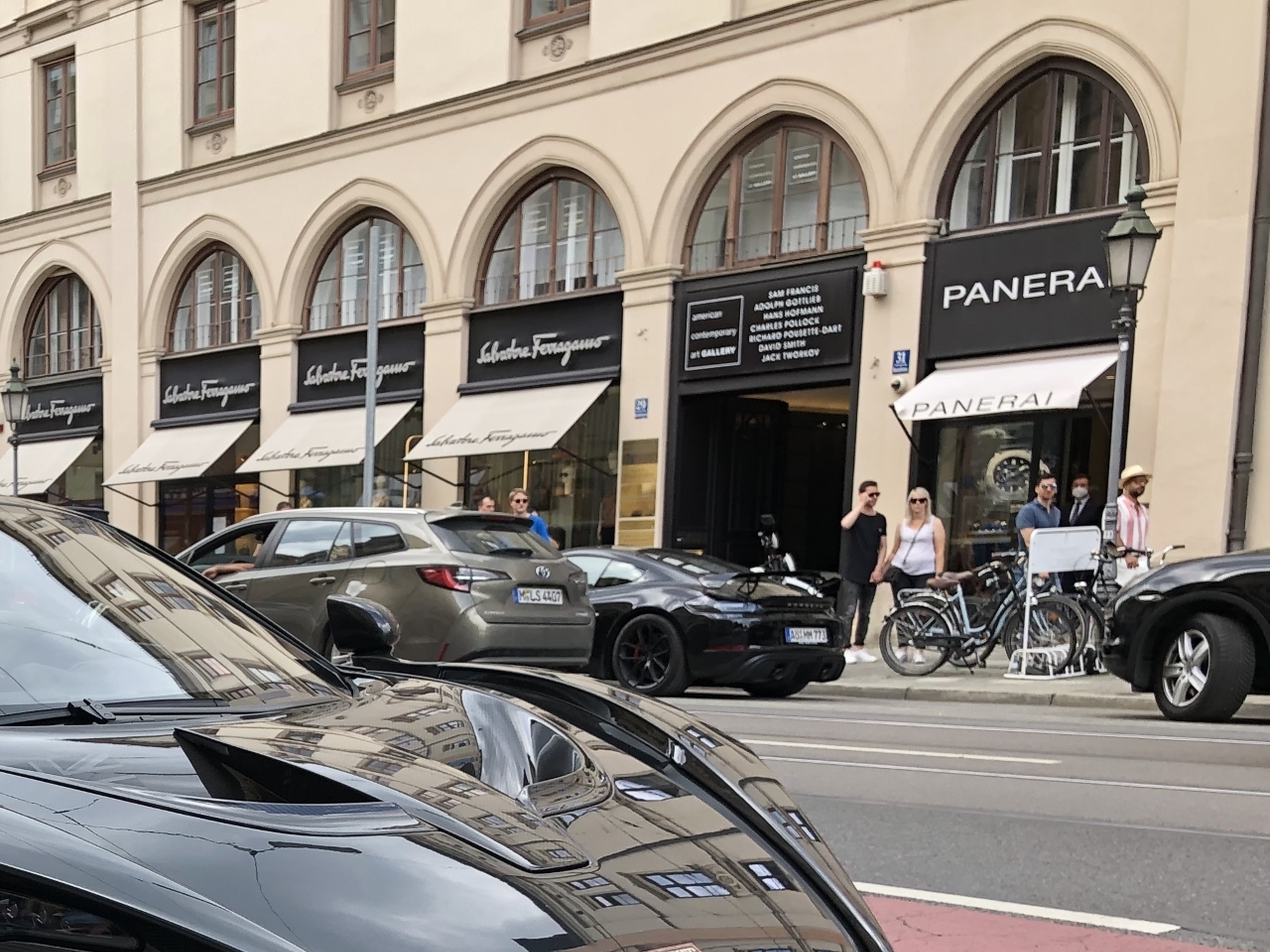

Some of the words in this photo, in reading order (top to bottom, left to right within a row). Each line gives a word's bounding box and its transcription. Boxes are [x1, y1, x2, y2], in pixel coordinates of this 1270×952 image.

[768, 289, 785, 299] SAM
[786, 284, 819, 297] FRANCIS
[942, 266, 1111, 309] PANERA
[753, 301, 784, 312] ADOLPH
[785, 295, 822, 307] GOTTLIEB
[691, 310, 723, 321] american
[763, 311, 783, 320] HANS
[784, 305, 824, 318] HOFMANN
[748, 332, 782, 343] RICHARD
[783, 323, 843, 340] POUSETTE-DART
[749, 322, 783, 333] CHARLES
[784, 317, 820, 329] POLLOCK
[690, 327, 737, 340] contemporary
[477, 338, 531, 364] Salvatore
[531, 333, 611, 366] Ferragamo
[690, 350, 700, 360] art
[700, 346, 736, 358] GALLERY
[758, 342, 782, 353] DAVID
[782, 340, 807, 350] SMITH
[761, 353, 781, 363] JACK
[782, 348, 820, 360] TWORKOV
[303, 361, 350, 386] Salvatore
[162, 384, 200, 405] Salvatore
[200, 379, 255, 408] Ferragamo
[49, 400, 96, 425] Ferragamo
[911, 391, 1053, 418] PANERAI
[426, 427, 479, 447] Salvatore
[478, 429, 558, 449] Ferragamo
[300, 446, 366, 462] Ferragamo
[155, 461, 209, 474] Ferragamo
